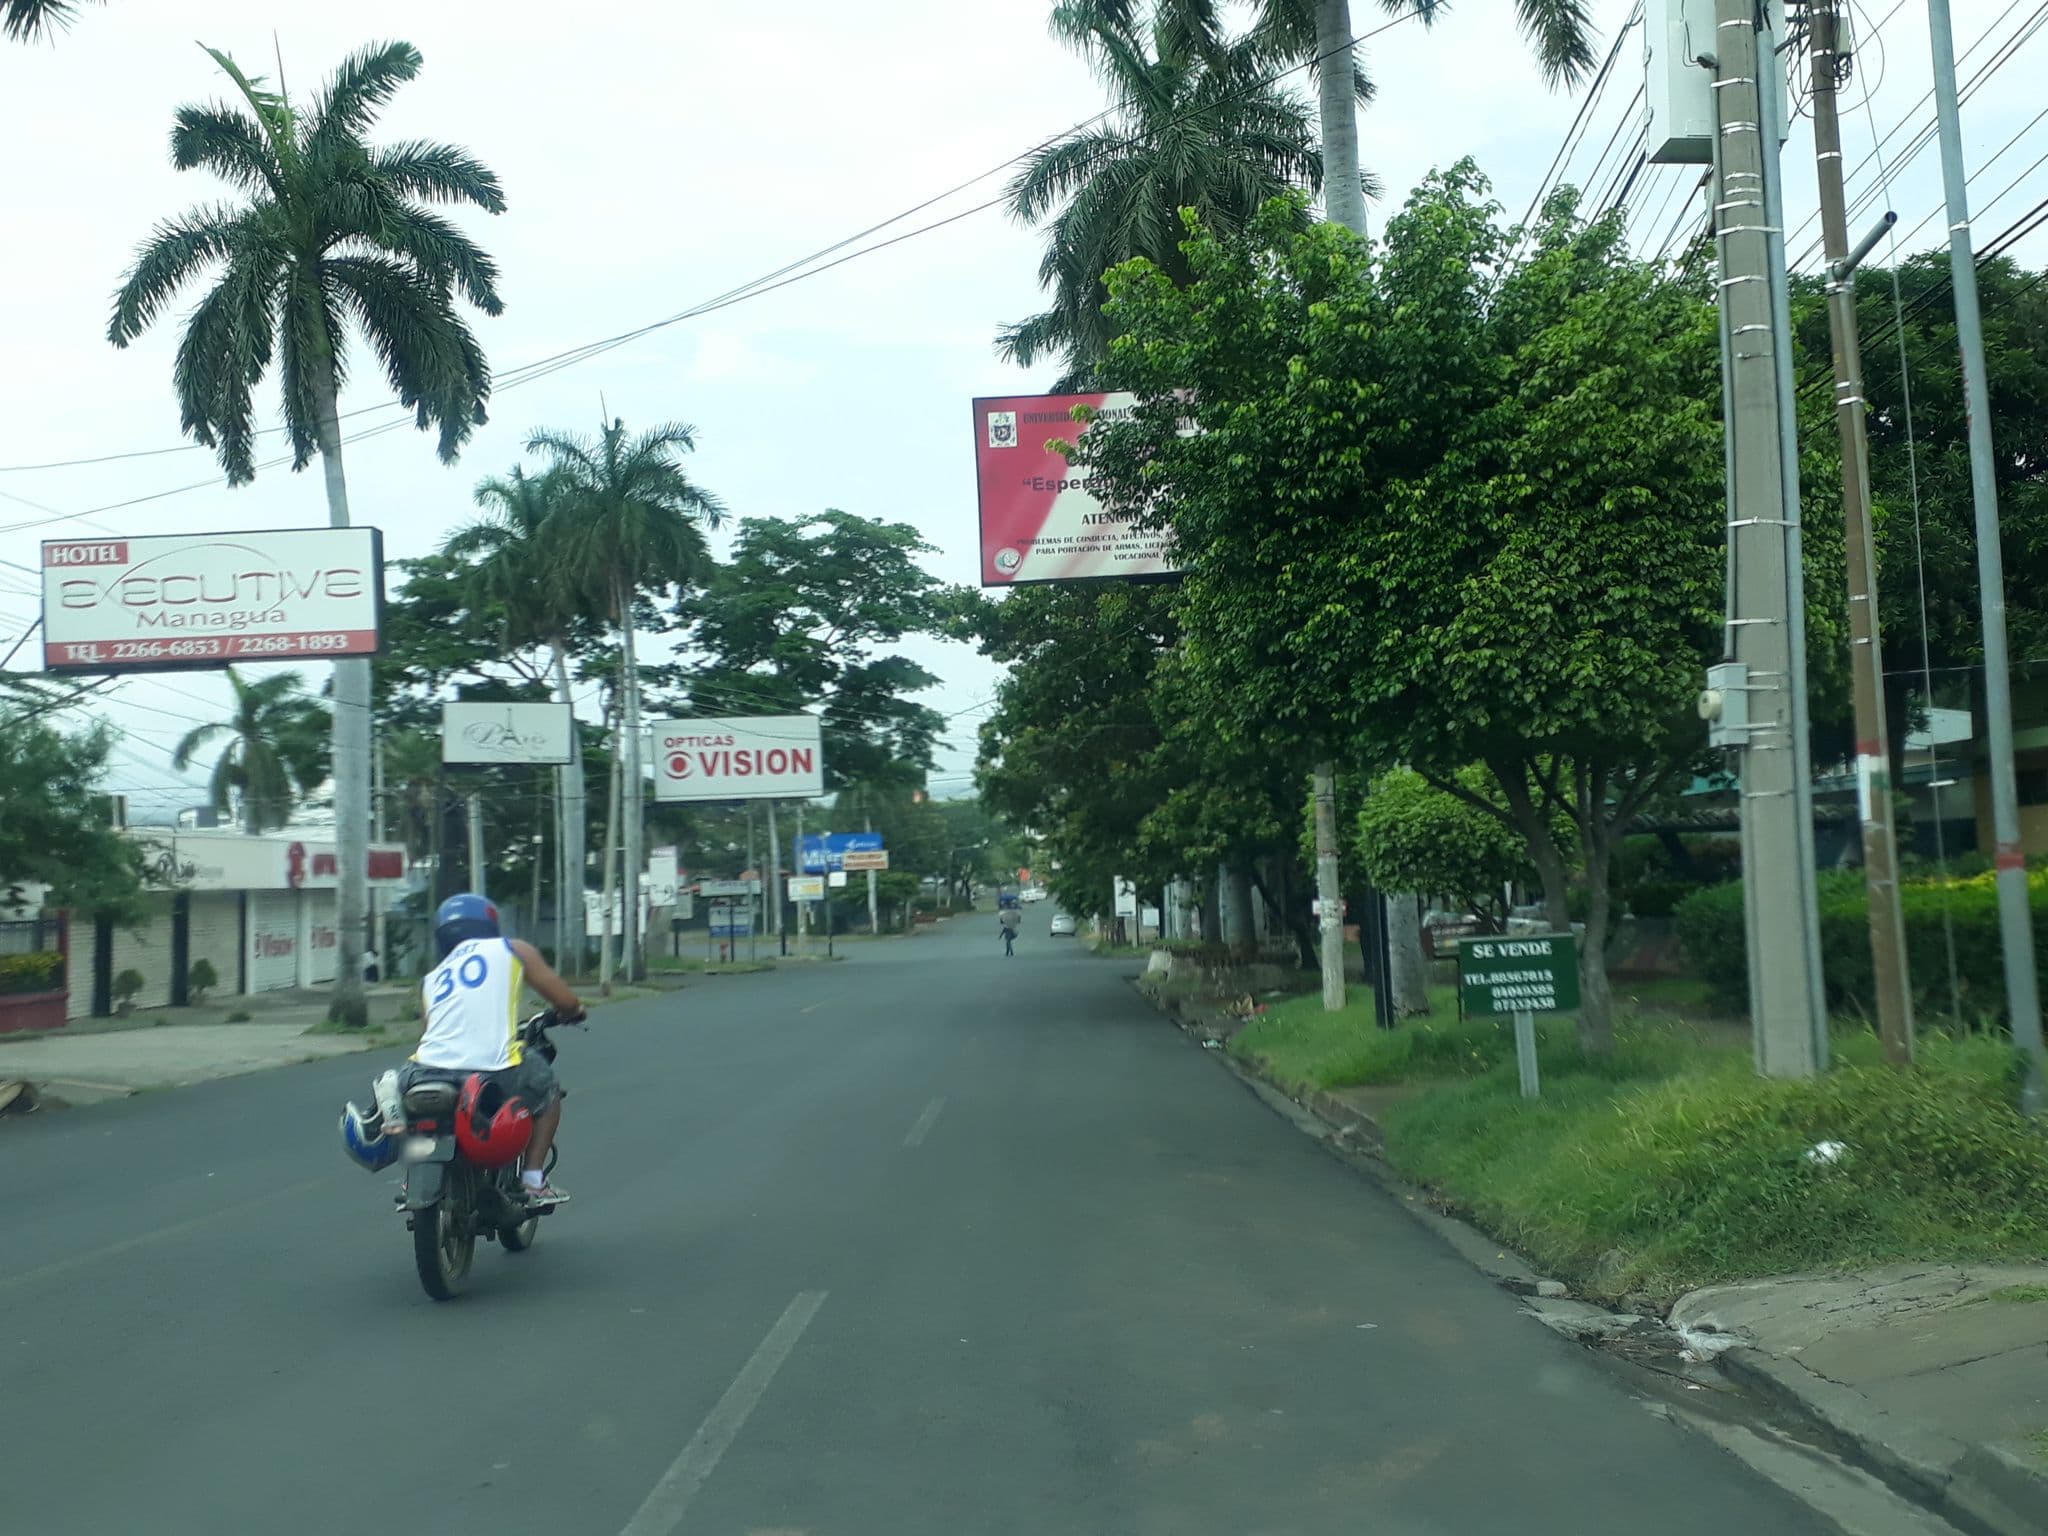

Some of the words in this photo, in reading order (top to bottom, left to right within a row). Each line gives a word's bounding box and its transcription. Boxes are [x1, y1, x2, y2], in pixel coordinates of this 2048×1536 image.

[52, 545, 120, 564] HOTEL
[136, 607, 288, 629] Managua
[111, 638, 219, 658] 2266-6853
[237, 634, 349, 653] 2268-1893
[663, 735, 735, 748] OPTICAS
[697, 747, 814, 777] VISION
[1472, 943, 1495, 959] SE
[1497, 940, 1552, 957] VENDE
[431, 953, 488, 1006] 30
